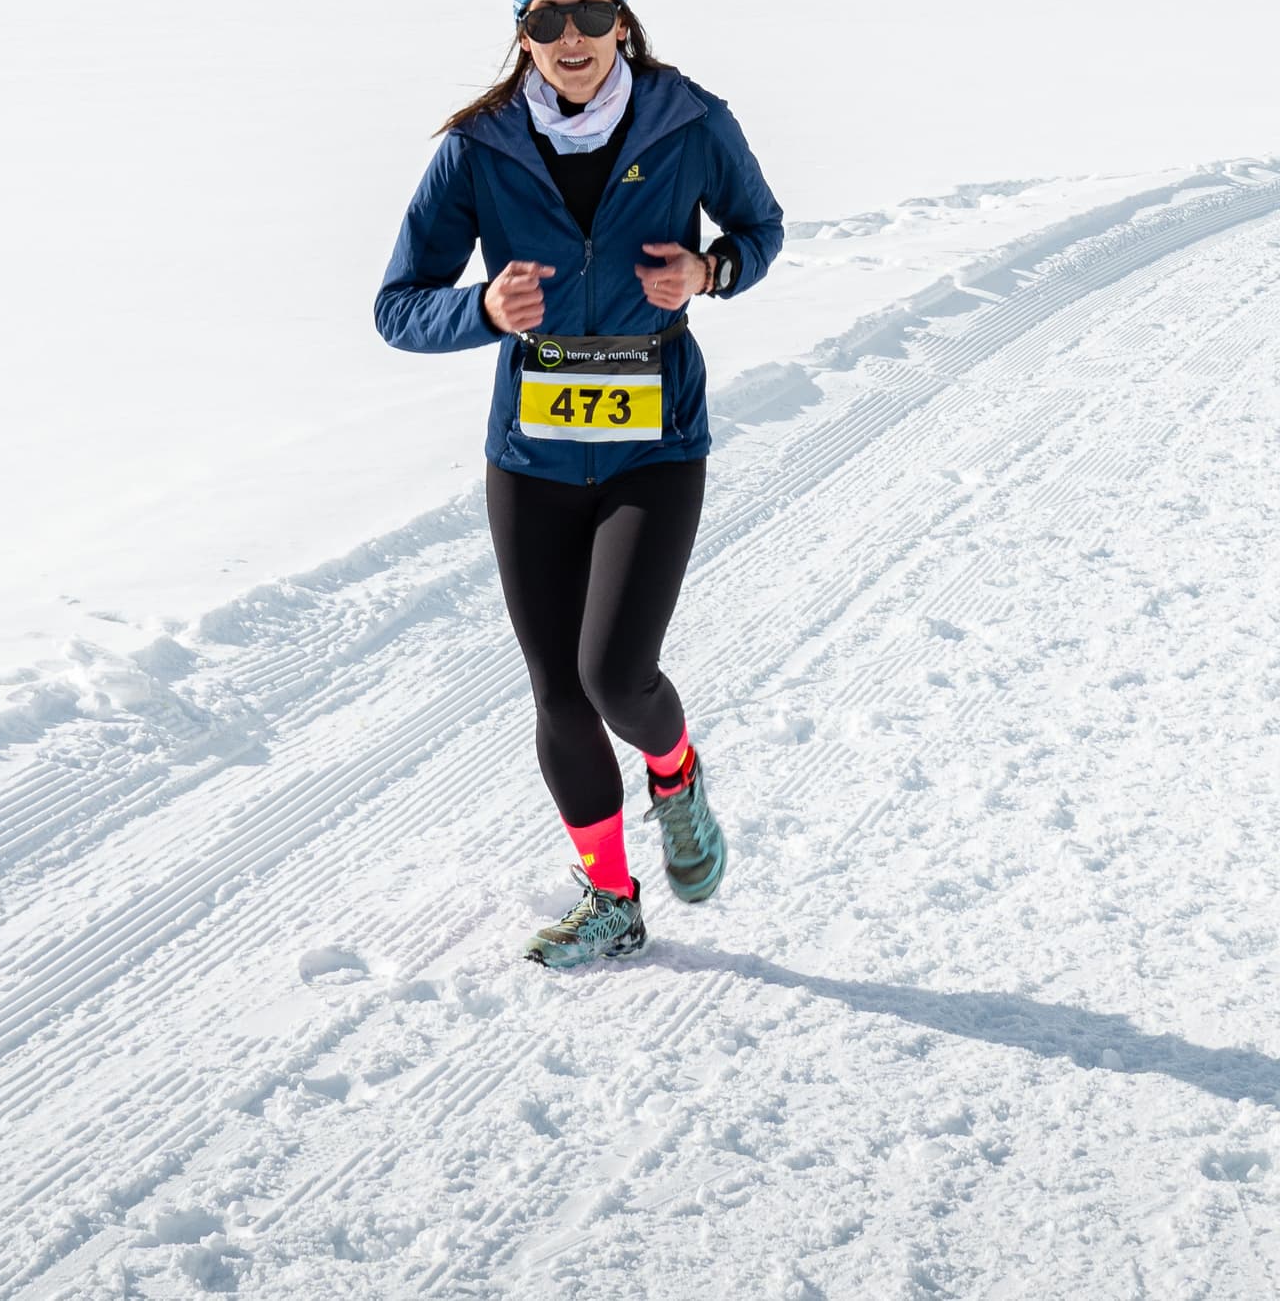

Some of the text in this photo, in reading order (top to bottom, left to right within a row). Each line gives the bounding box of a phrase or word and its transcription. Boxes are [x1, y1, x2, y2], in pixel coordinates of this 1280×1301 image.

[566, 349, 649, 362] terre de running
[550, 387, 632, 425] 473
